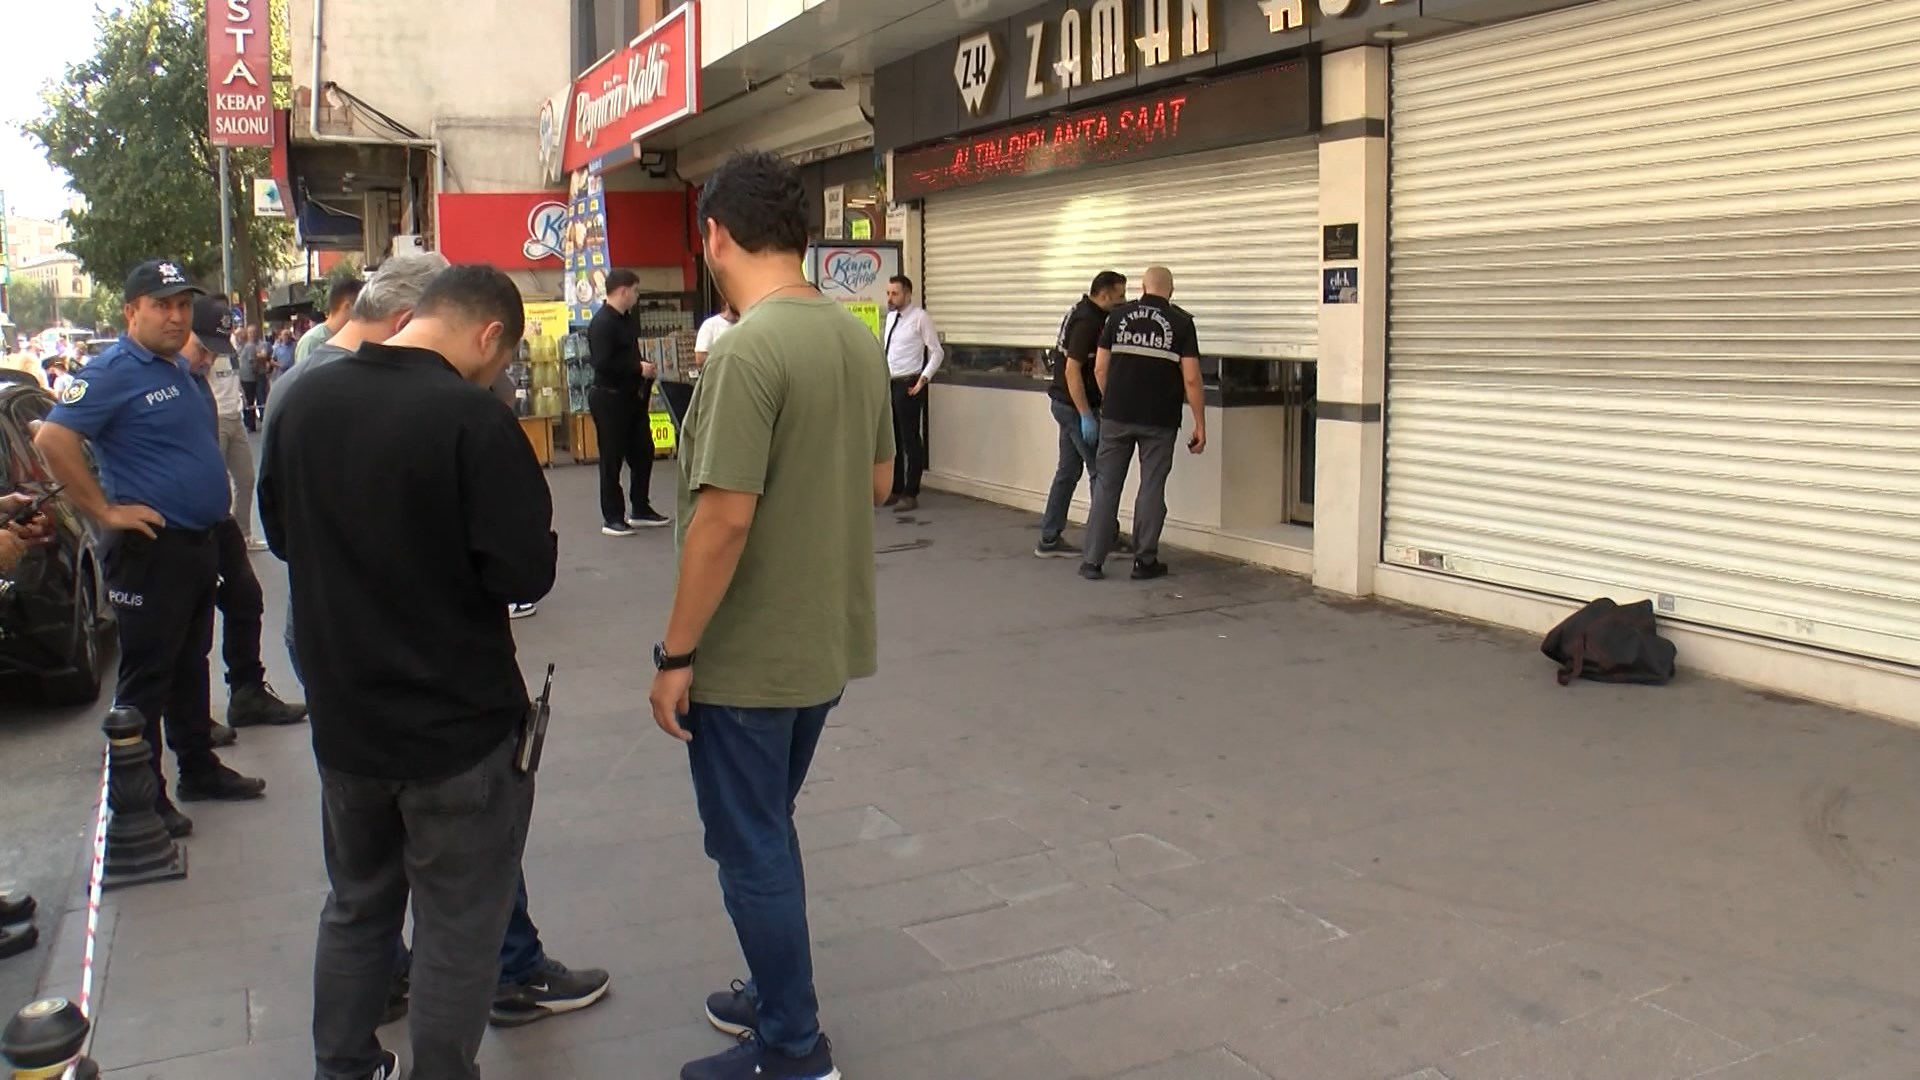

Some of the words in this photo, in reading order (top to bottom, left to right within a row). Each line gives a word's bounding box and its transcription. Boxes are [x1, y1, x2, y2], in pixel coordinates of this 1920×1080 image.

[625, 42, 668, 113] Kalbi
[215, 93, 266, 110] KEBAP
[215, 117, 269, 134] SALONU
